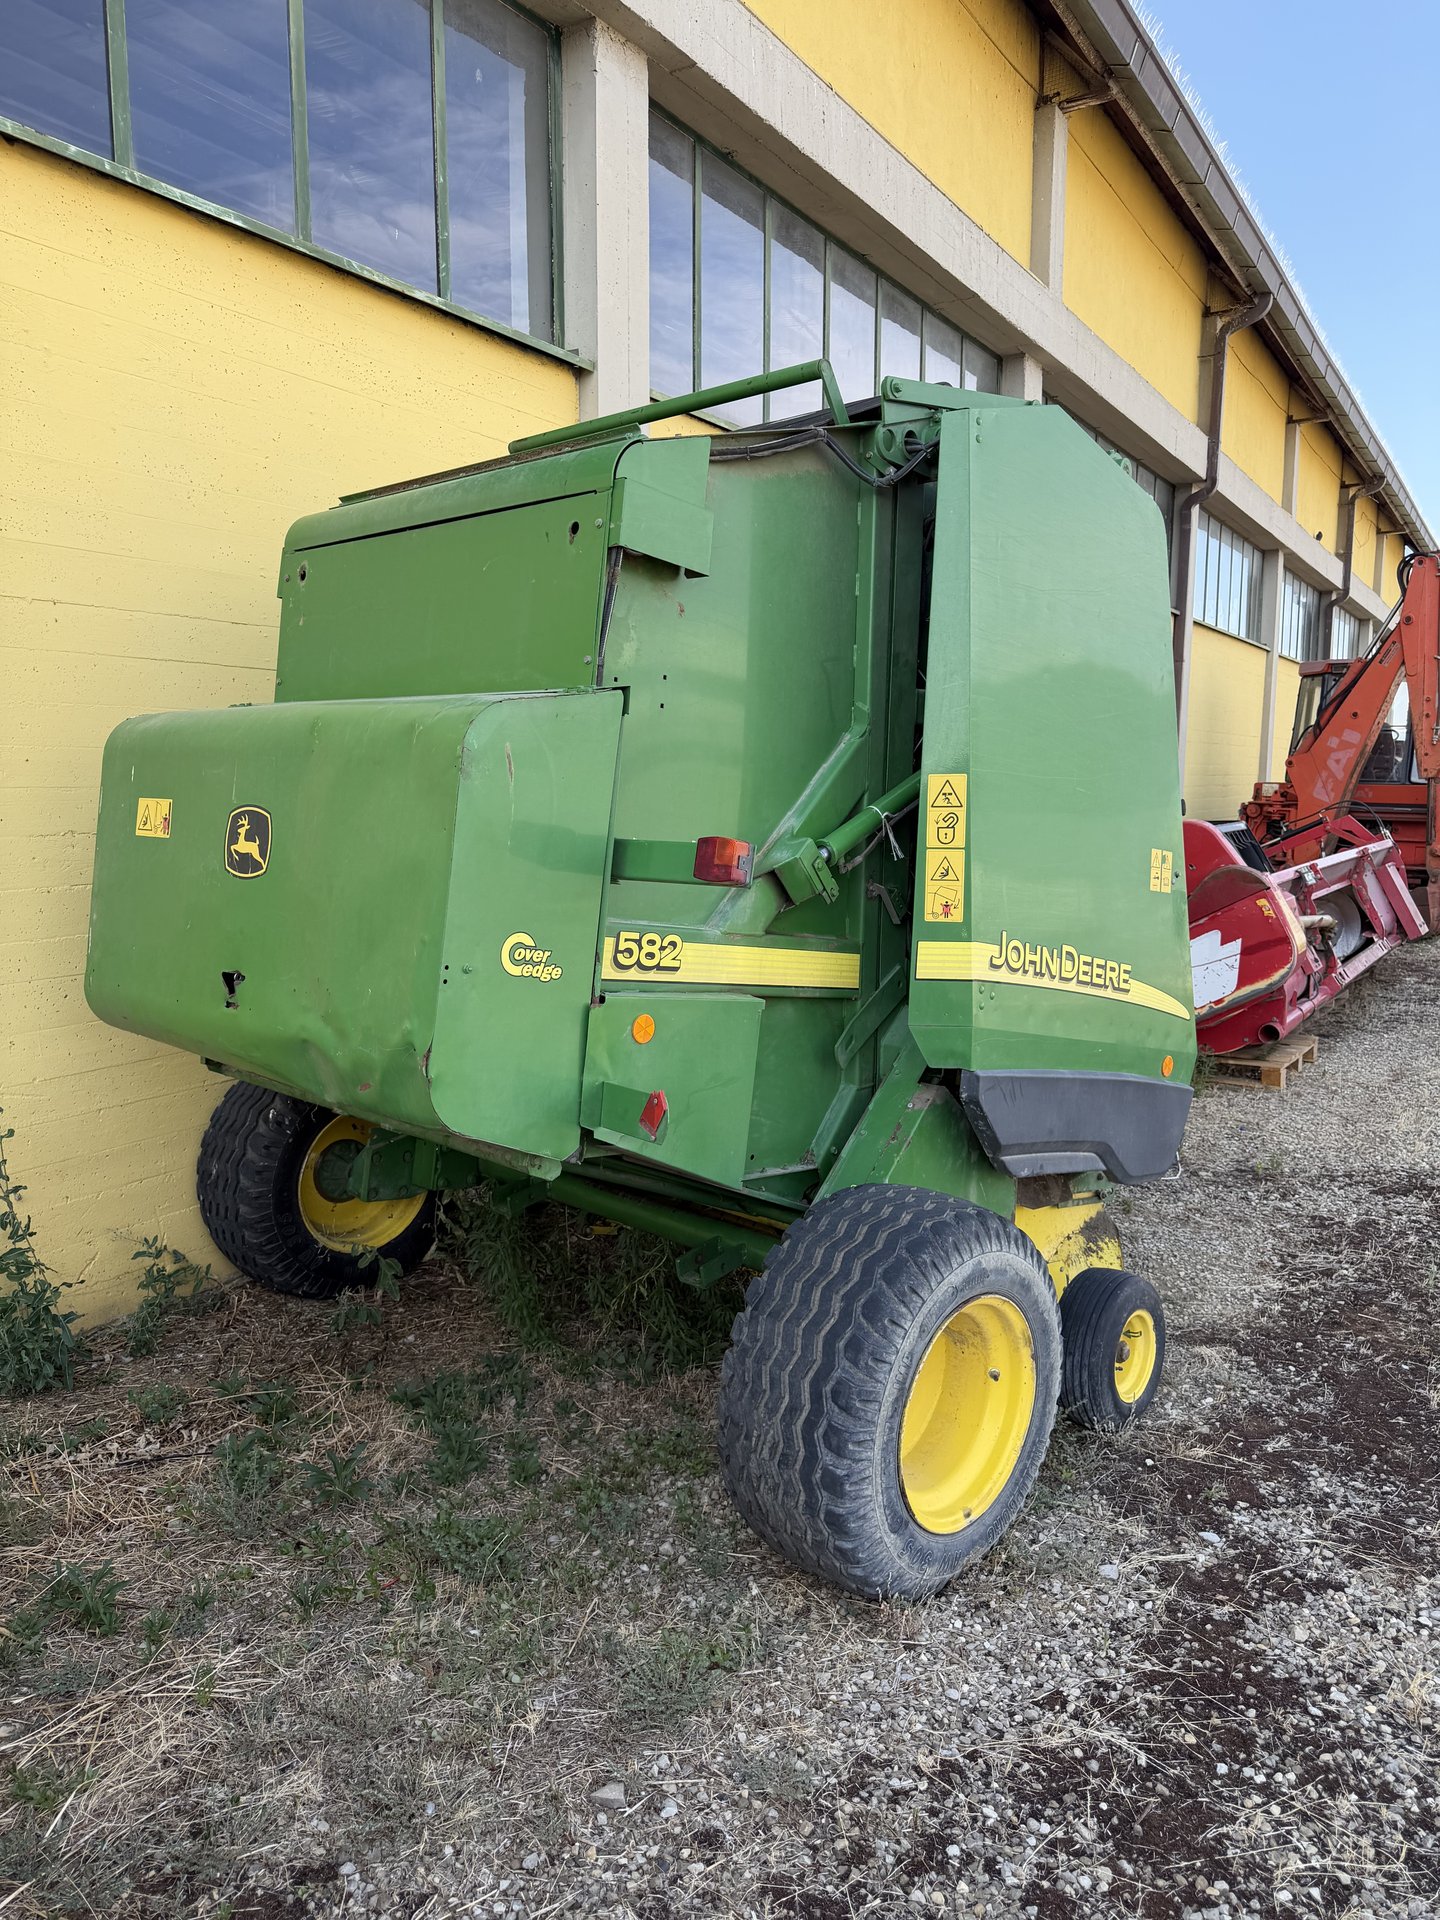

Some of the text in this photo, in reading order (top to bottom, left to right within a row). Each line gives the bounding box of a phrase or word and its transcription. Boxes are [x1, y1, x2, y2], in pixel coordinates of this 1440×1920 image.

[613, 931, 683, 974] 582
[990, 930, 1132, 993] JOHN DEERE
[521, 962, 563, 983] edge
[897, 1538, 934, 1574] 305
